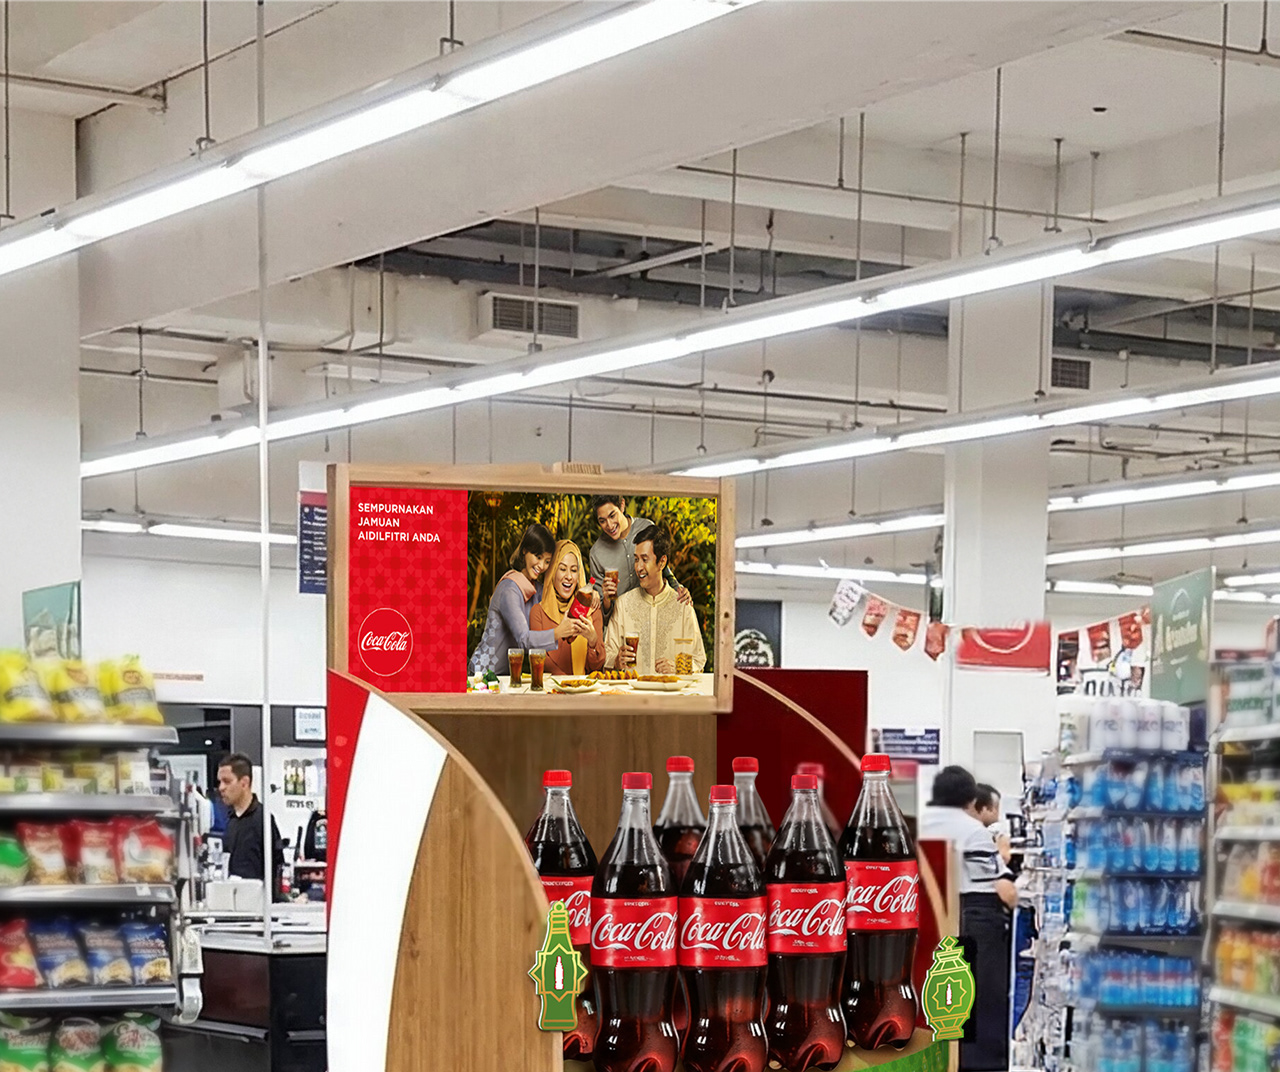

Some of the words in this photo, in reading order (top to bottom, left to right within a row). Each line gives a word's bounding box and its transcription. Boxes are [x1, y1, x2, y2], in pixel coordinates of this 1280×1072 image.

[358, 503, 434, 514] SEMPURNAKAN
[358, 517, 400, 527] JAMUAN
[358, 531, 410, 541] AIDILFITRI
[412, 533, 441, 542] ANDA
[361, 631, 410, 651] Coca-Cola
[846, 874, 919, 913] oca-Cola
